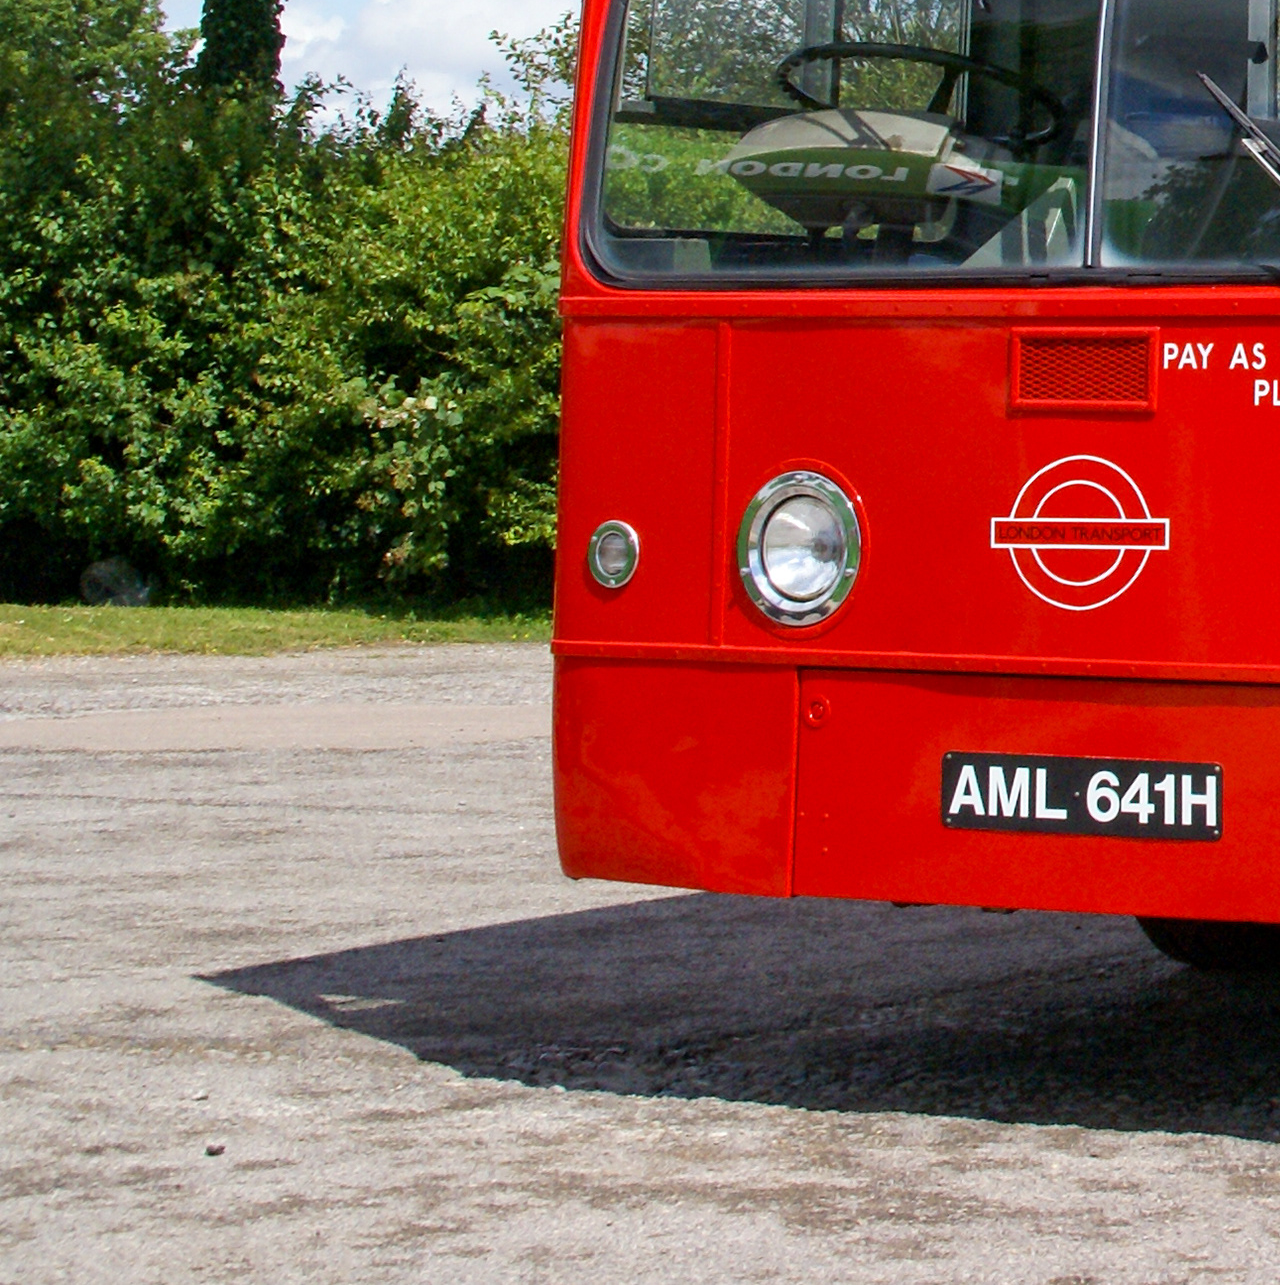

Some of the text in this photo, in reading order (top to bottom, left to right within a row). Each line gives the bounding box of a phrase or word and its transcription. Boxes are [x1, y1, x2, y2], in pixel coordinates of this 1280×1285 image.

[1162, 342, 1215, 371] PAY
[1229, 343, 1268, 371] AS
[998, 525, 1162, 542] LONDON TRANSPORT
[948, 763, 1218, 829] AML 641H
